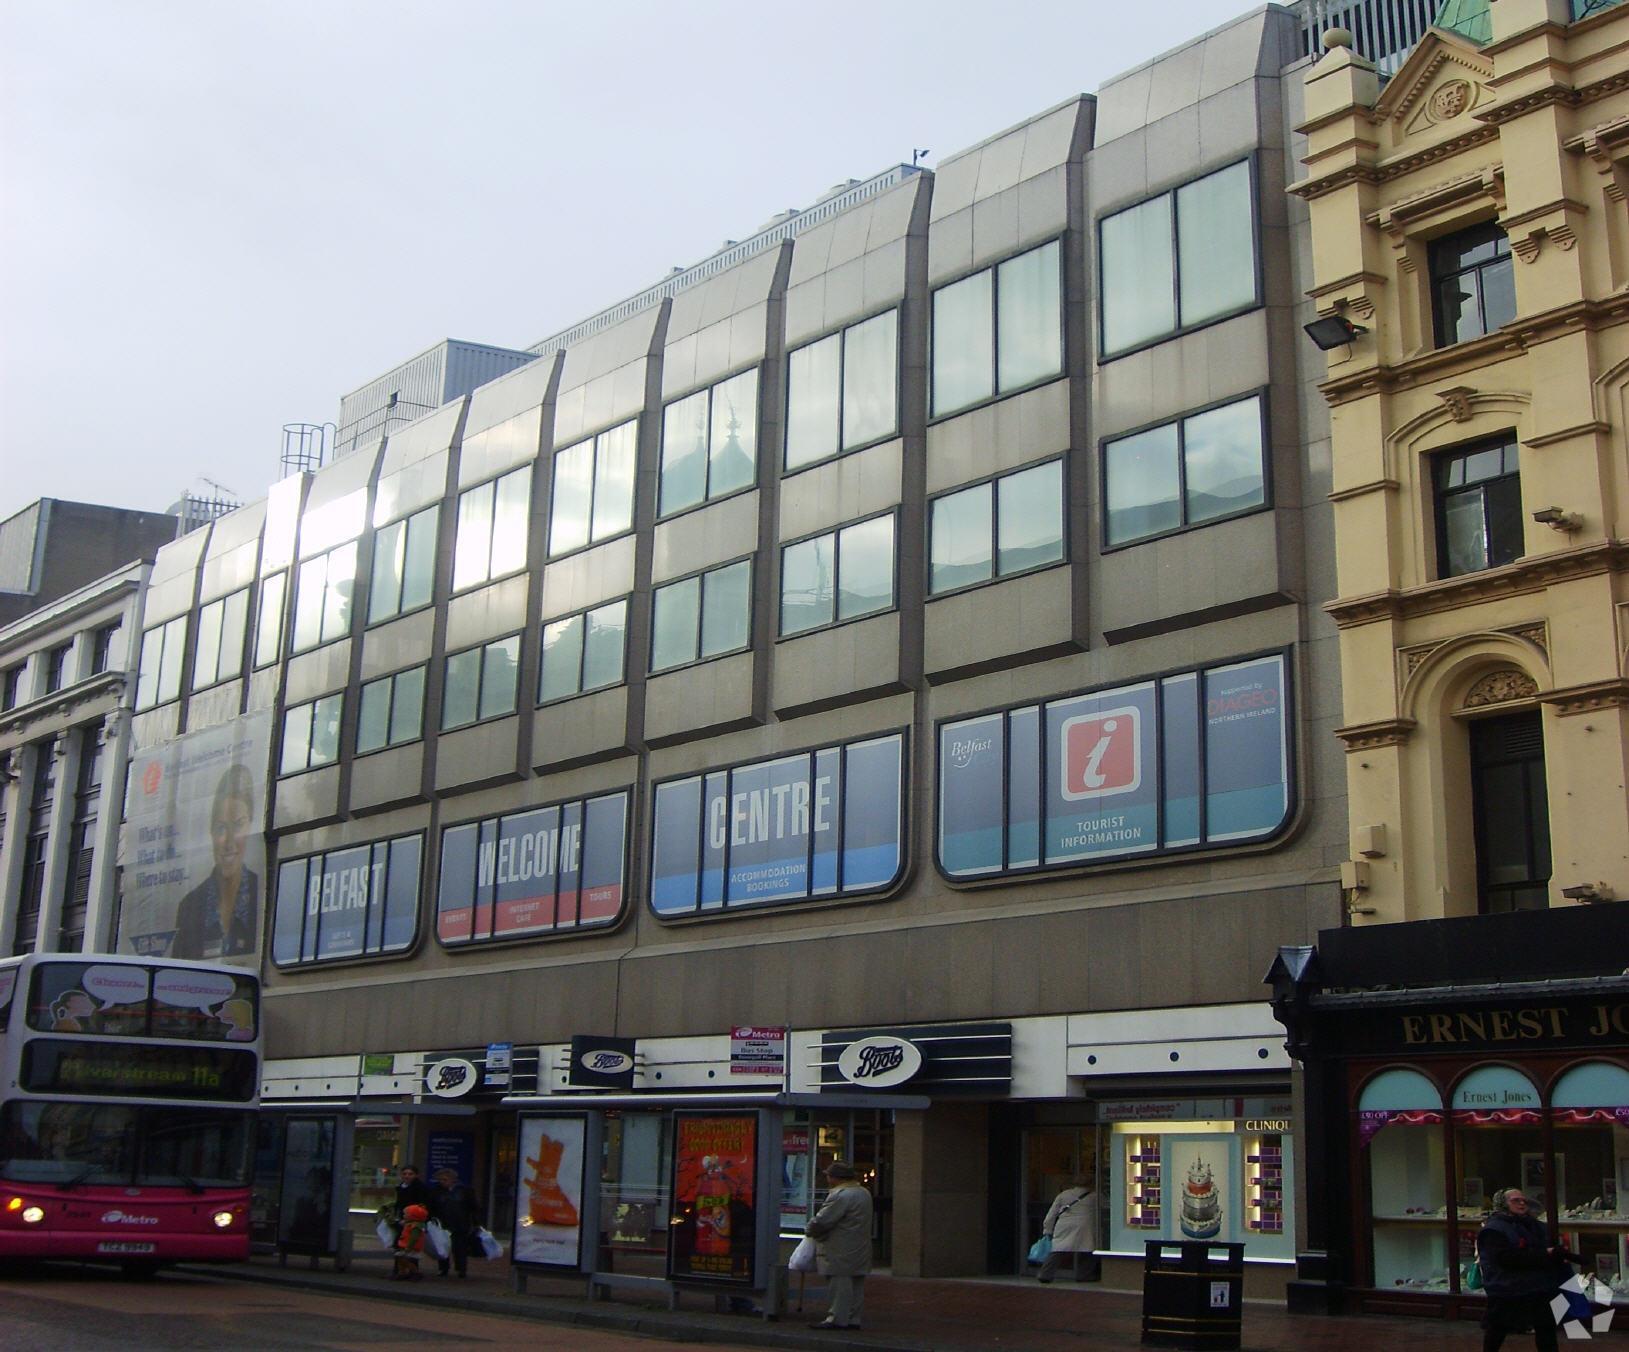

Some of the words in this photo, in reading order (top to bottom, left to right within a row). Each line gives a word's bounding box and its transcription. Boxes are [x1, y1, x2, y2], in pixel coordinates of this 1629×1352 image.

[1208, 688, 1278, 717] DIAGEO
[951, 738, 992, 764] Belfast
[710, 776, 831, 849] CENTRE
[1077, 815, 1126, 833] TOURIST
[1061, 827, 1142, 849] INFORMATION
[479, 824, 581, 888] WELCOME
[731, 863, 806, 884] ACCOMMODATION
[308, 863, 383, 916] BELFAST
[746, 877, 790, 893] BOOKINGS
[589, 890, 613, 902] TOURS
[752, 1031, 781, 1039] Metro
[1400, 1007, 1569, 1045] ERNEST
[593, 1053, 625, 1069] Boots
[756, 1047, 774, 1055] Stop
[853, 1045, 904, 1078] Boots
[192, 1065, 221, 1087] 11a
[1462, 1089, 1498, 1104] Ernest
[1502, 1089, 1533, 1105] Jones
[120, 1214, 160, 1225] Metro
